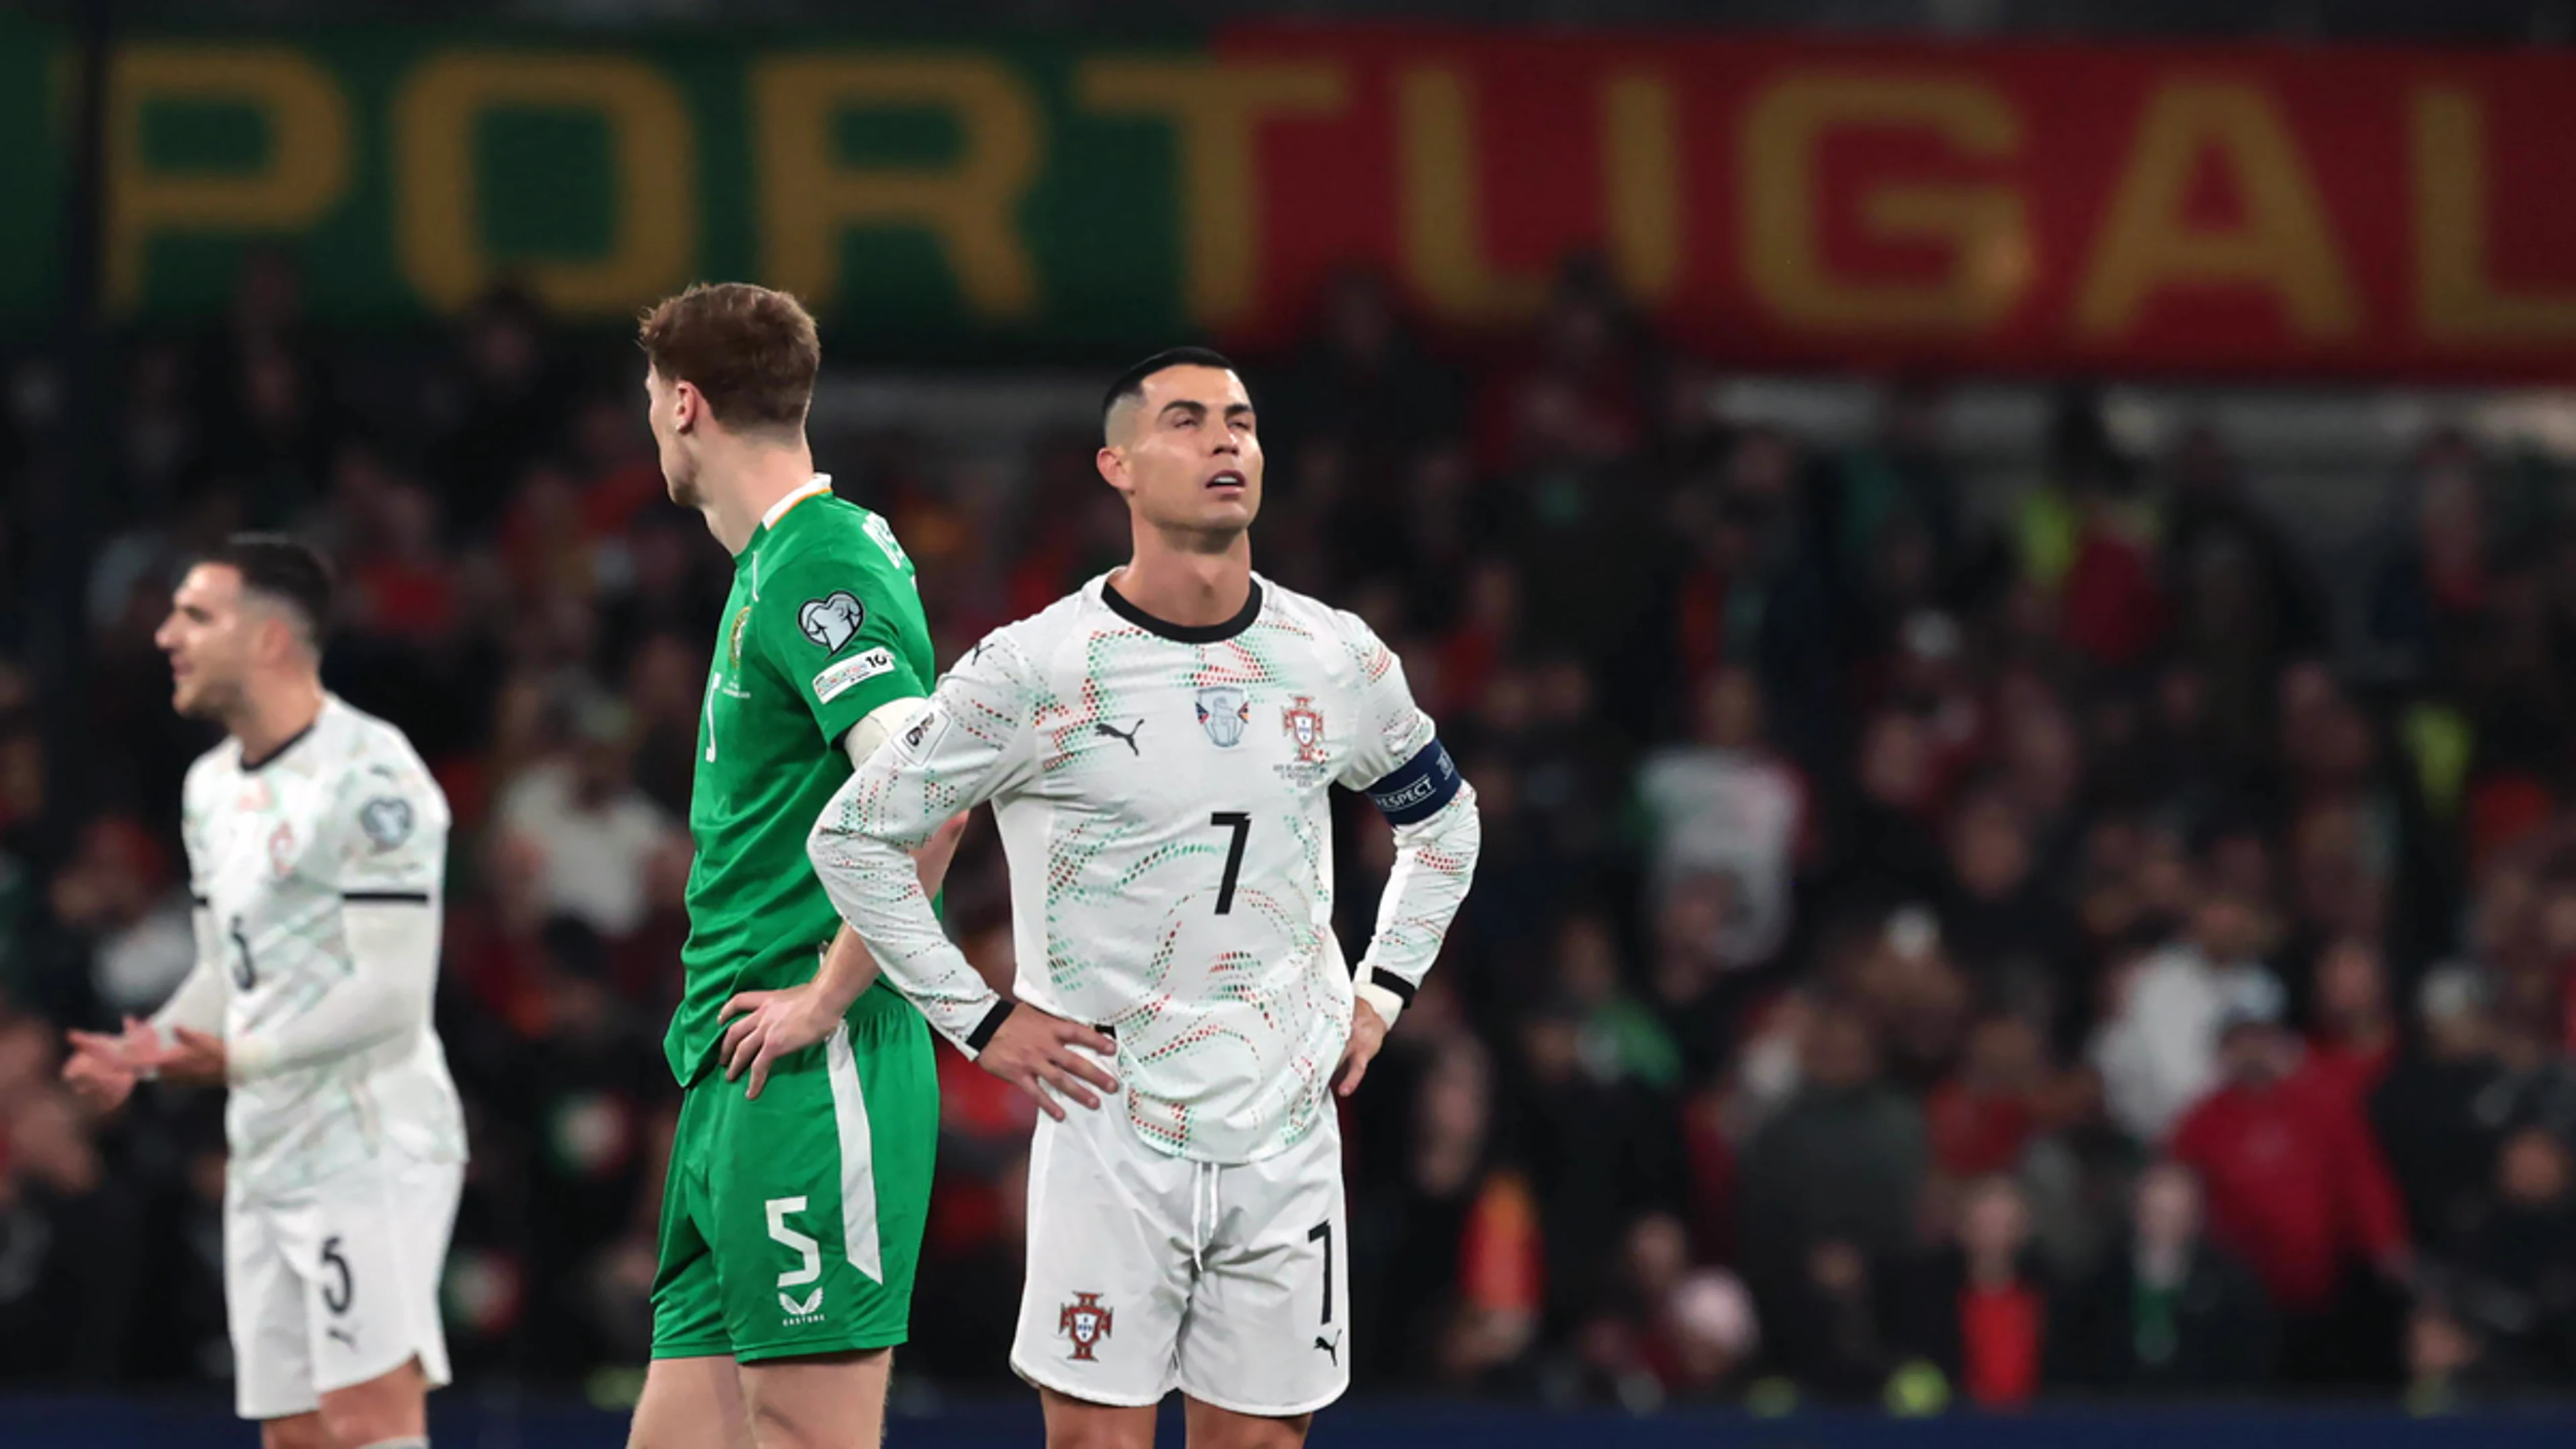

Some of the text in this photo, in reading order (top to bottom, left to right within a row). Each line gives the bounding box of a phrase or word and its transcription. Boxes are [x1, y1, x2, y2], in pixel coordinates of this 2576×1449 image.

[99, 42, 2576, 339] PORTUGAL
[1210, 812, 1251, 915] 7
[231, 915, 255, 991] 5
[321, 1235, 354, 1318] 5
[765, 1195, 821, 1287] 5
[1307, 1219, 1332, 1326] 7
